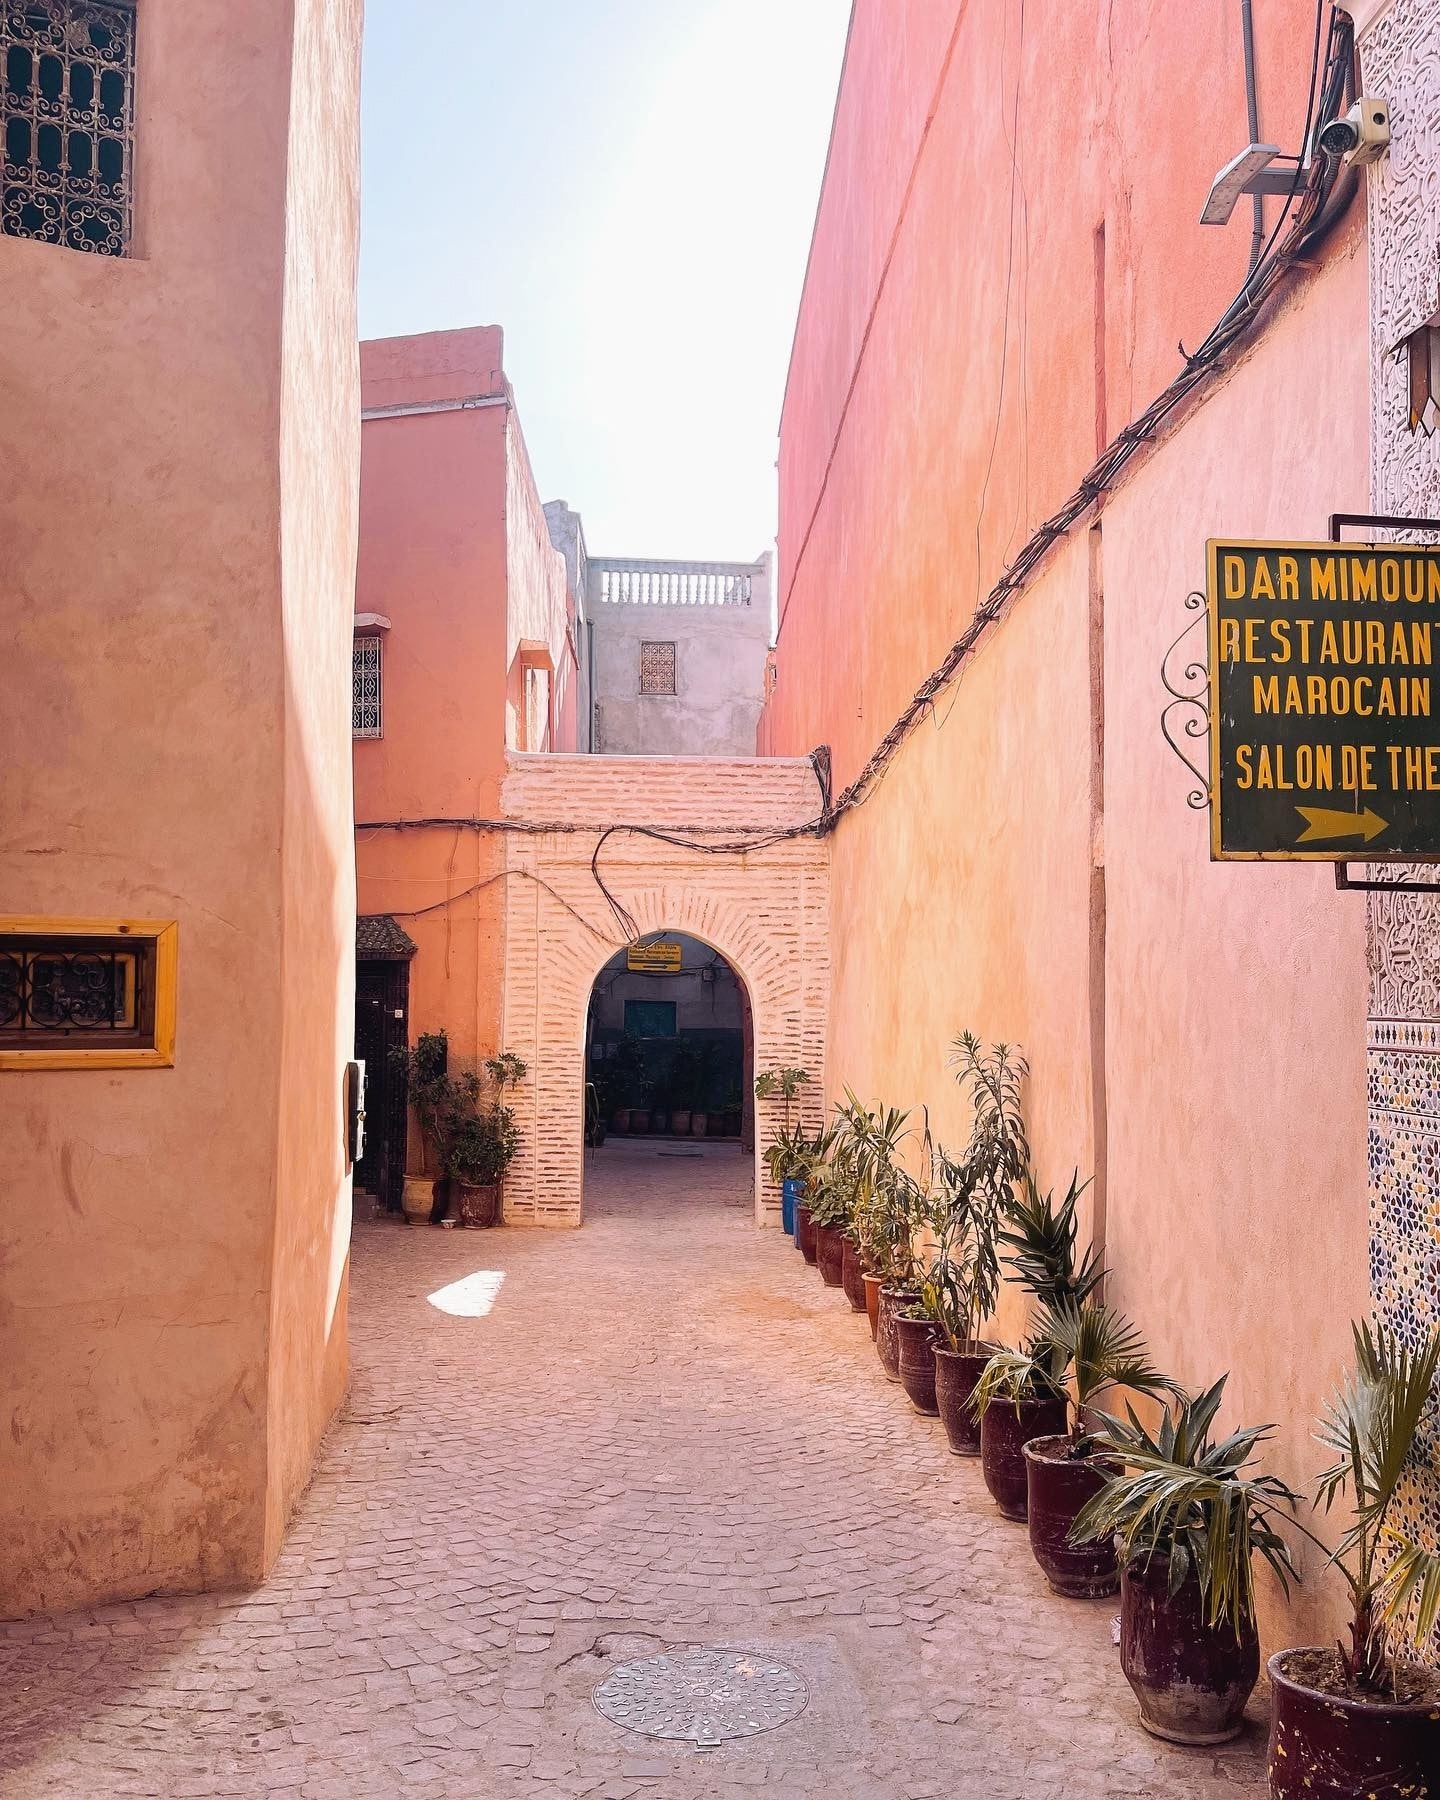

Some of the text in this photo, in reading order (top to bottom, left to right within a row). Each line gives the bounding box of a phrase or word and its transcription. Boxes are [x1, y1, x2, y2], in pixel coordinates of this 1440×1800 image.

[1224, 555, 1300, 601] DAR
[1253, 675, 1430, 716] MAROCAIN
[1235, 744, 1440, 791] SALON DE THE
